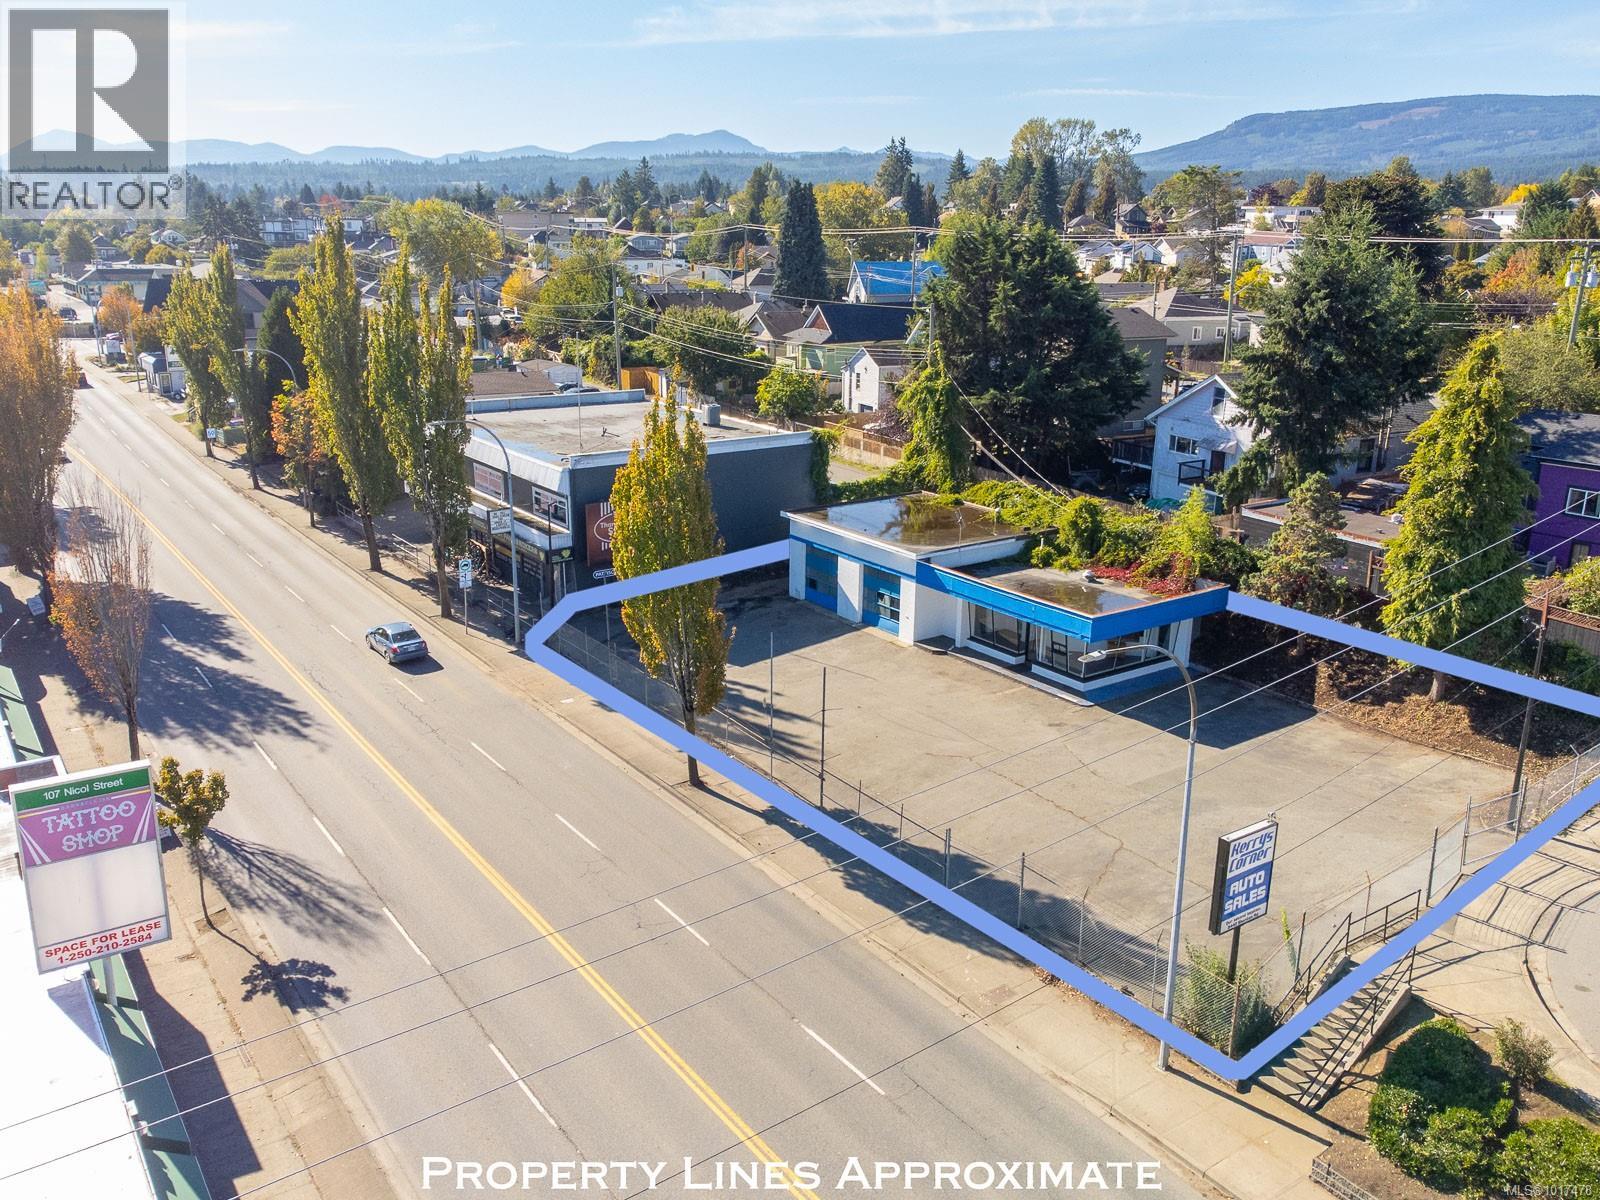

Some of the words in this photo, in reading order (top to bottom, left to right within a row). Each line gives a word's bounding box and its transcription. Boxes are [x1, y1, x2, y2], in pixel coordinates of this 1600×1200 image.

[43, 790, 60, 801] 107
[64, 784, 90, 797] Nicol
[93, 778, 124, 791] Street
[41, 800, 136, 834] TATTOO
[62, 825, 124, 853] SHOP
[1229, 846, 1272, 873] Corner
[1229, 870, 1265, 897] AUTO
[1224, 886, 1266, 915] SALES
[45, 940, 88, 958] SPACE
[92, 932, 117, 946] FOR
[121, 920, 161, 938] LEASE
[57, 932, 153, 965] 1-250-210-2584
